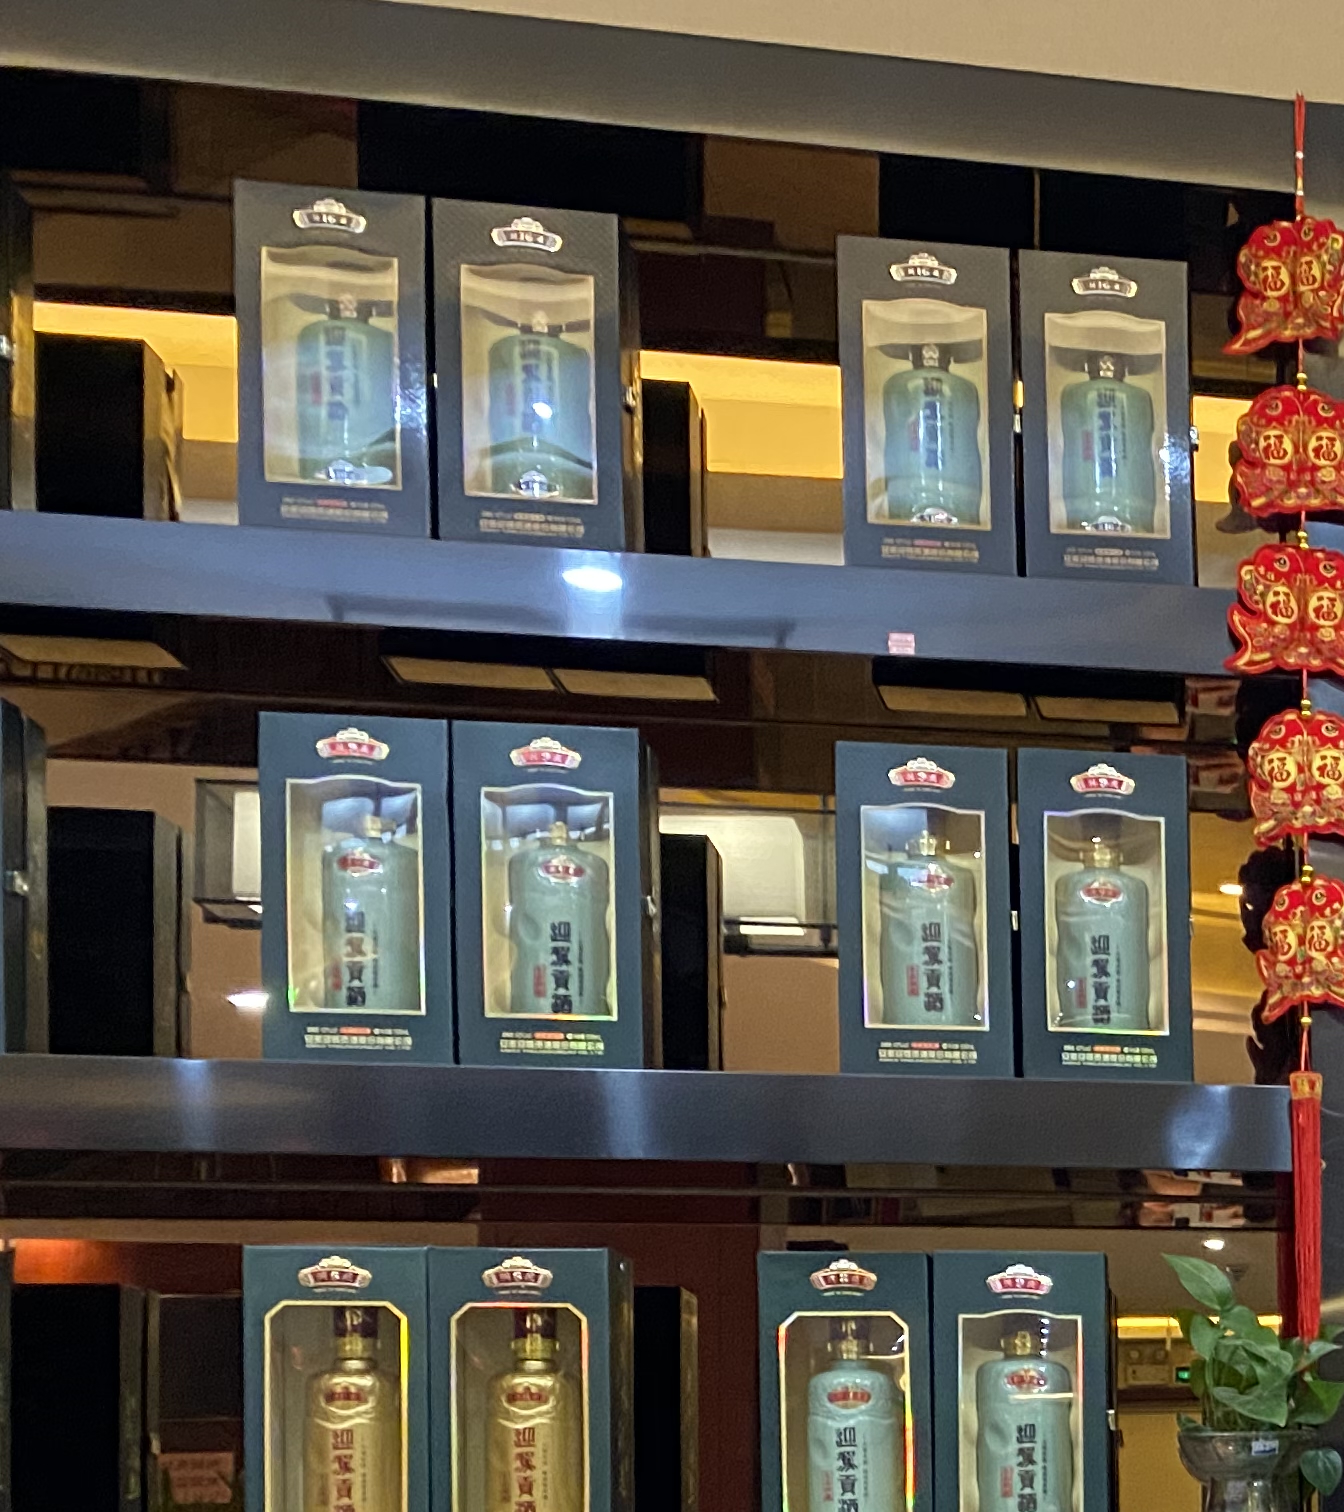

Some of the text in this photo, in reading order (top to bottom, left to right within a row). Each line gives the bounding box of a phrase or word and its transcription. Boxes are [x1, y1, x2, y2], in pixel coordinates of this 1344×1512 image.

[1262, 263, 1288, 292] 福
[1263, 434, 1293, 461] 福
[1310, 435, 1341, 463] 福
[1269, 591, 1294, 620] 福
[1310, 594, 1339, 622] 福
[1268, 757, 1295, 784] 福
[1317, 755, 1344, 783] 福
[1308, 923, 1331, 953] 福
